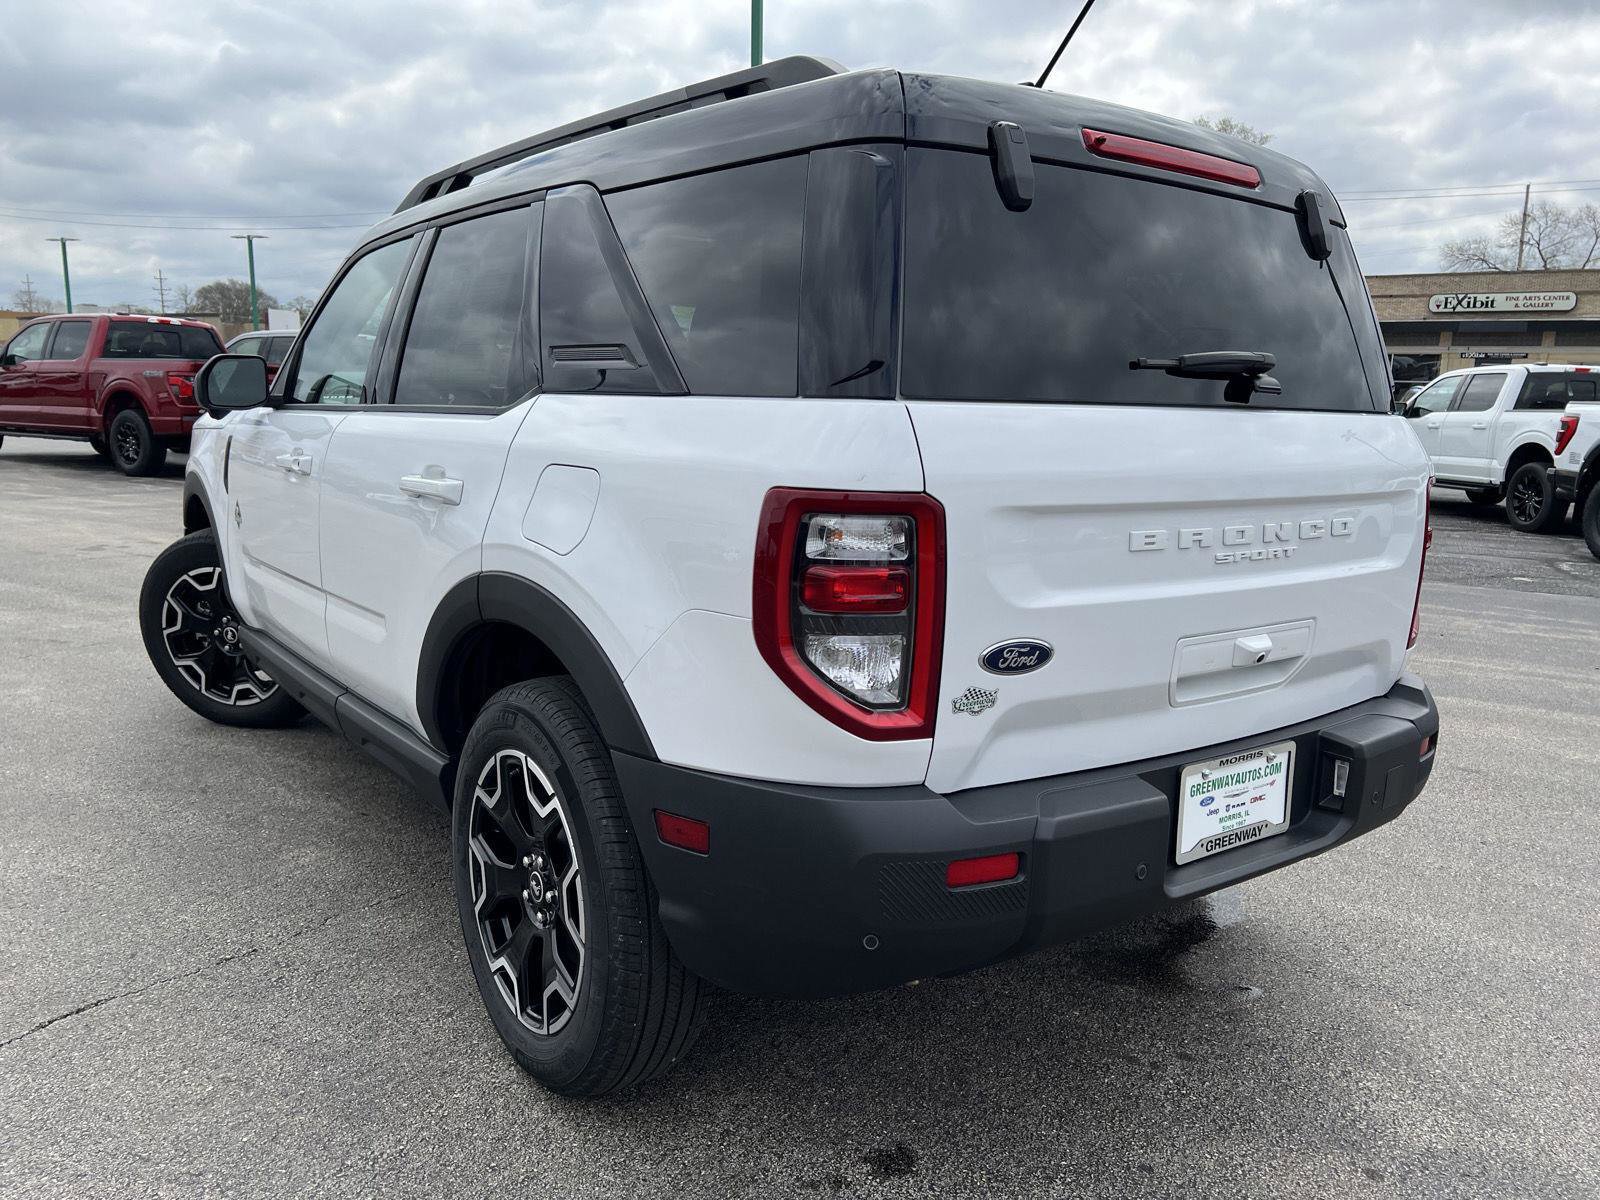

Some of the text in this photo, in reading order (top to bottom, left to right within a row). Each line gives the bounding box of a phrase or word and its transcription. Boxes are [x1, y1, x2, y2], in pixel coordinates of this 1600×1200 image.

[1443, 294, 1497, 312] EXibit
[1543, 293, 1570, 301] CENTER
[1129, 518, 1354, 552] BRONCO
[1214, 546, 1298, 564] SPORT
[998, 647, 1040, 669] Ford
[1219, 750, 1264, 767] MORRIS
[1190, 762, 1283, 798] GREENWAYAUTOS.COM
[1207, 808, 1219, 817] Jeep
[1205, 824, 1264, 853] GREENWAY
